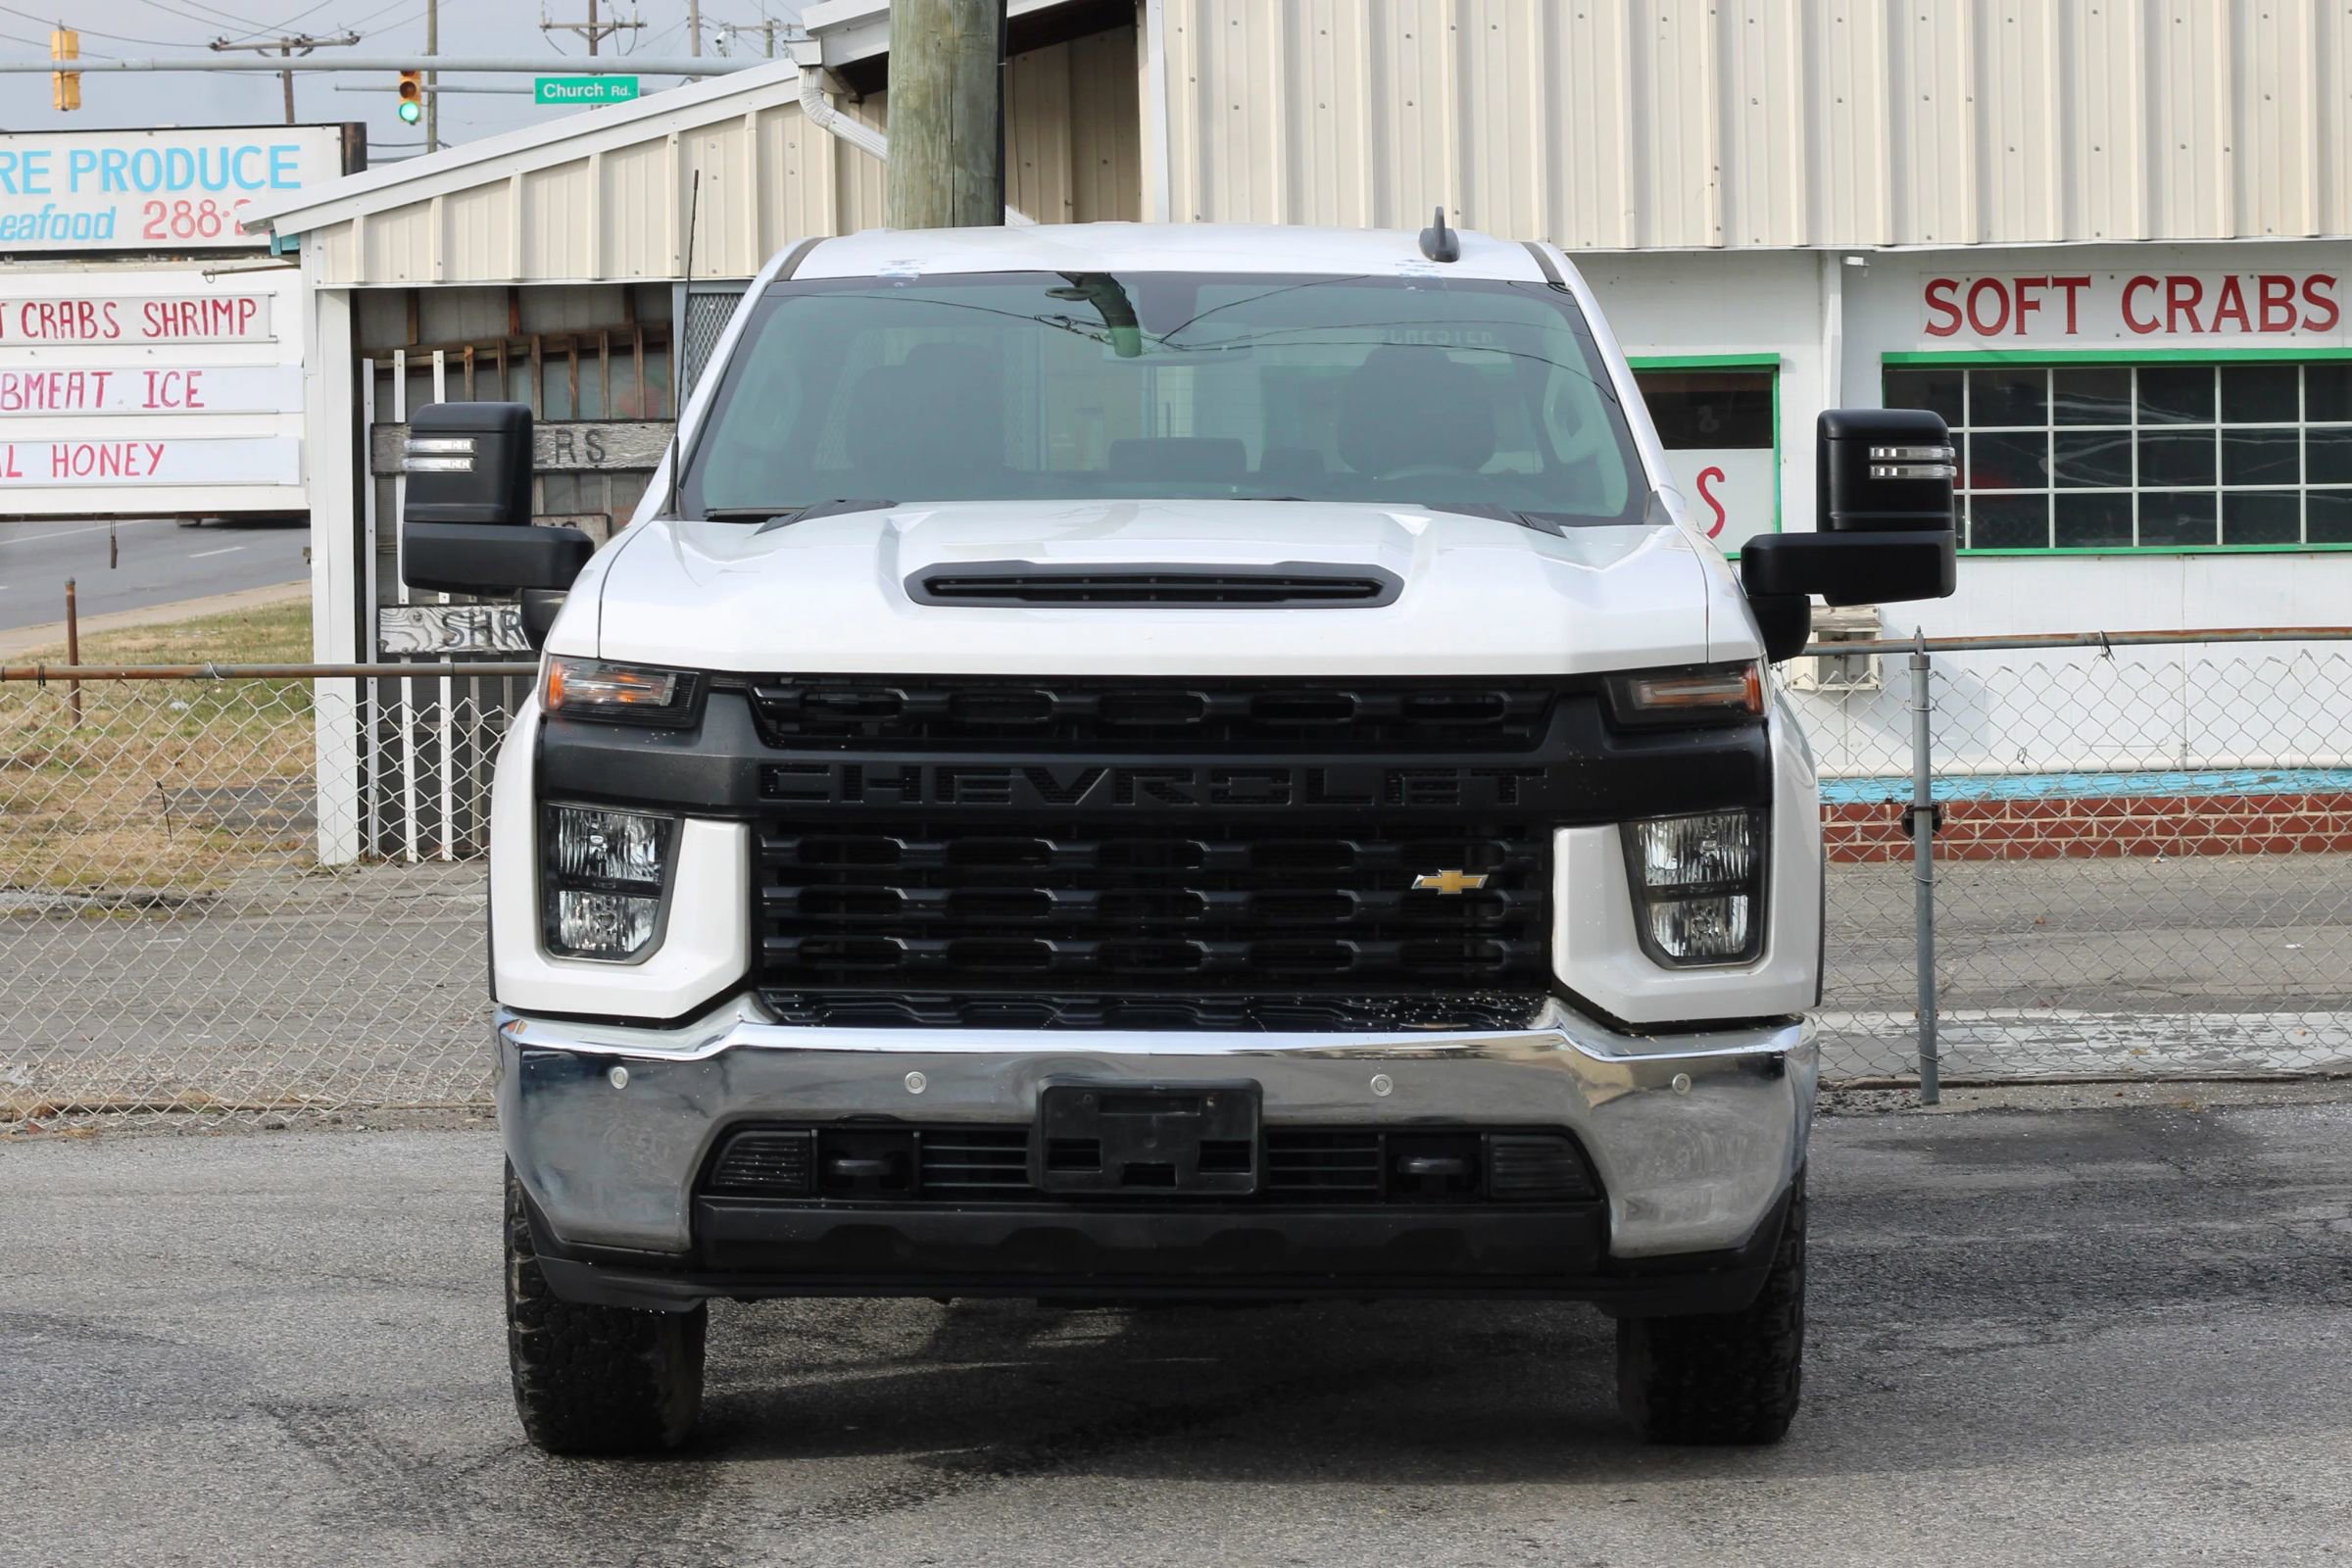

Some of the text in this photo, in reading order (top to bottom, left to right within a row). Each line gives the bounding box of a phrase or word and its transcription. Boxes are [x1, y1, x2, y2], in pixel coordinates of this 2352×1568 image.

[543, 82, 631, 98] Church Rd.
[0, 144, 301, 194] RE PRODUCE
[0, 203, 117, 241] eafood
[21, 301, 121, 339] CRABS
[142, 298, 257, 336] SHRIMP
[1924, 273, 2339, 336] SOFT CRABS
[1, 370, 205, 411] BMEAT ICE
[0, 443, 165, 478] L HONEY
[758, 763, 1549, 807] CHEVROLET
